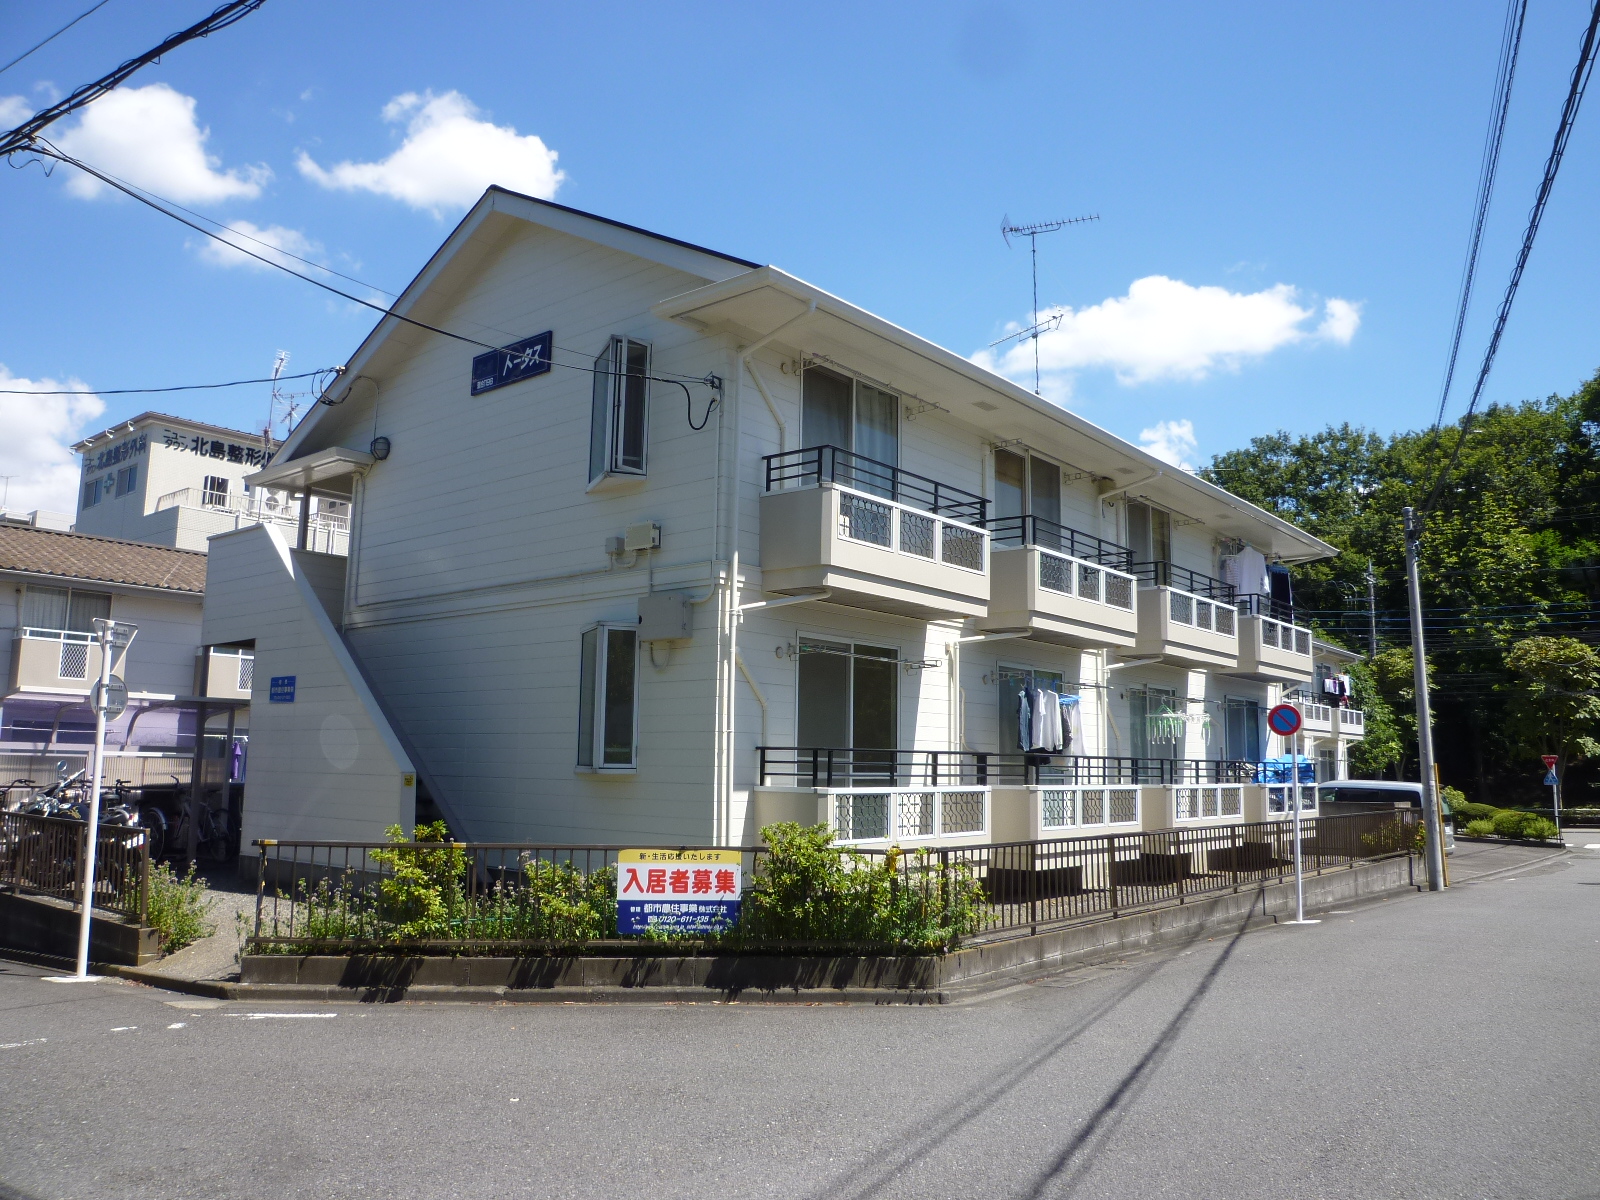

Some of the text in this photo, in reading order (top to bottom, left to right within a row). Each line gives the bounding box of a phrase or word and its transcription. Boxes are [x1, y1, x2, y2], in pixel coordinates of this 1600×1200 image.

[502, 344, 542, 377] トータス
[163, 429, 187, 440] ニュー
[164, 439, 188, 452] タウン
[622, 868, 736, 894] 入居者募集
